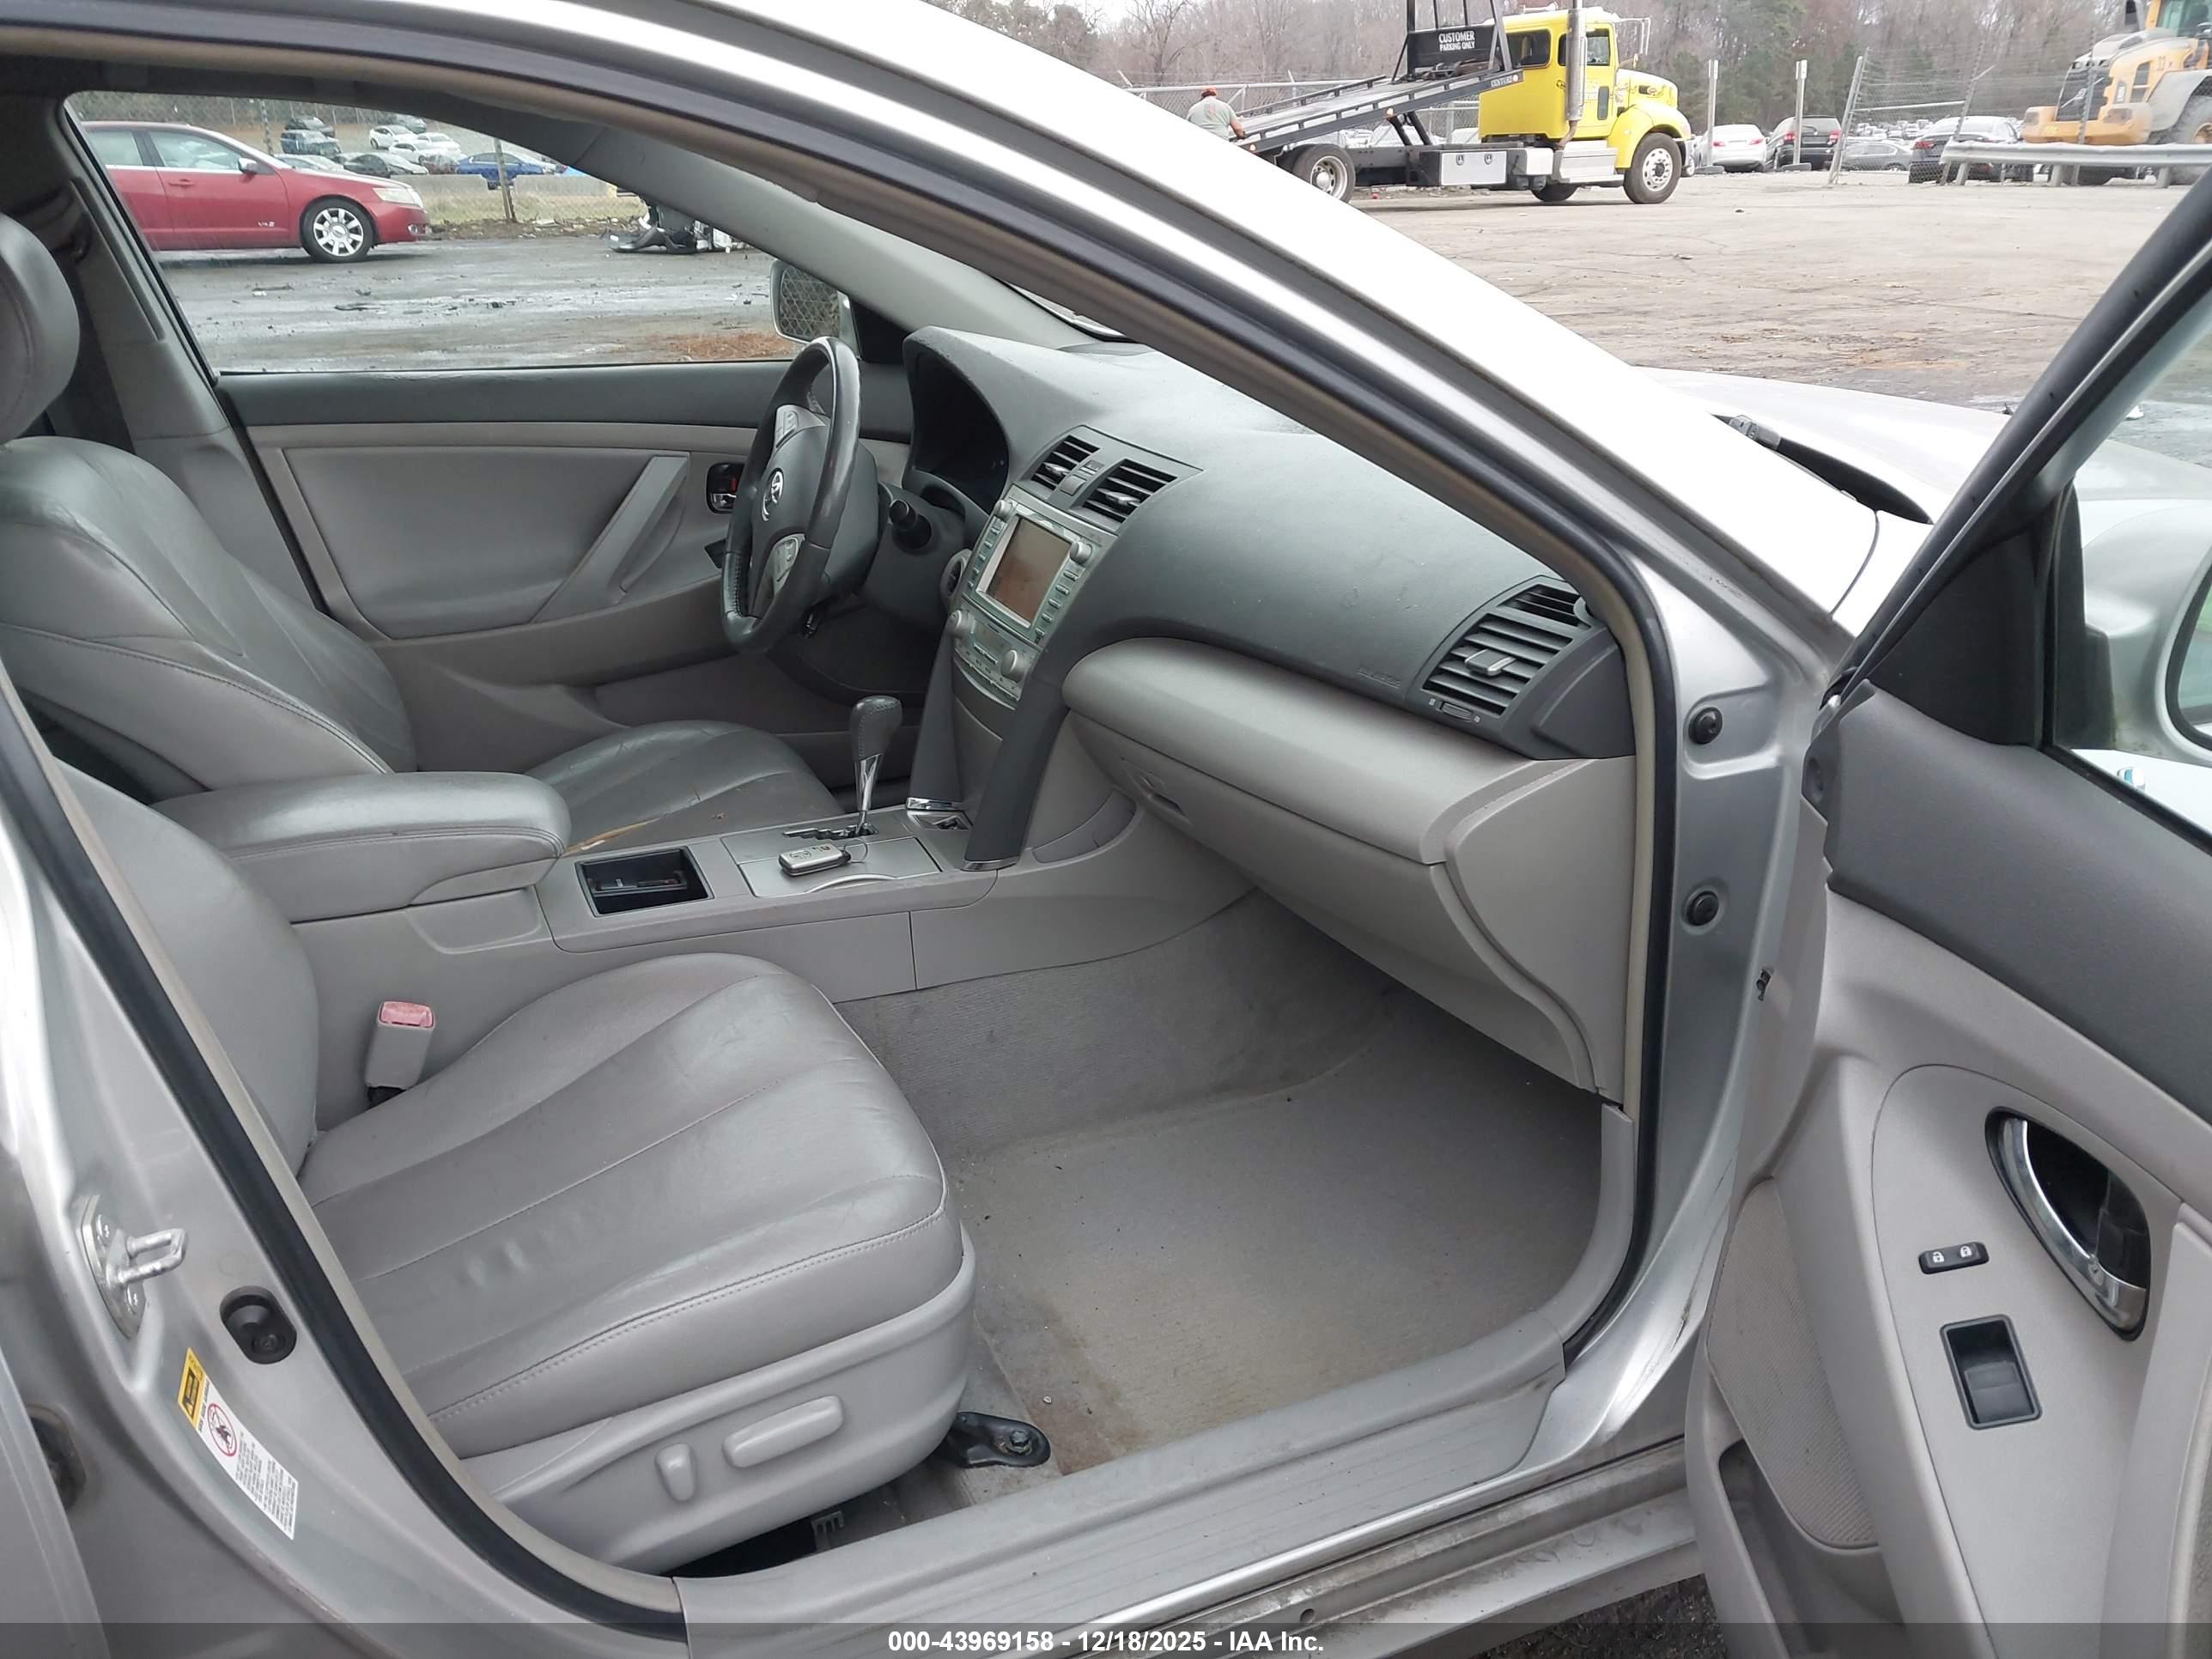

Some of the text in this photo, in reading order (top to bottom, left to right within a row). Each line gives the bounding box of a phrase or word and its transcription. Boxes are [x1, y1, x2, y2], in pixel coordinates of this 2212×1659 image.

[1438, 30, 1475, 43] CUSTOMER
[1439, 40, 1475, 52] PARKING ONLY
